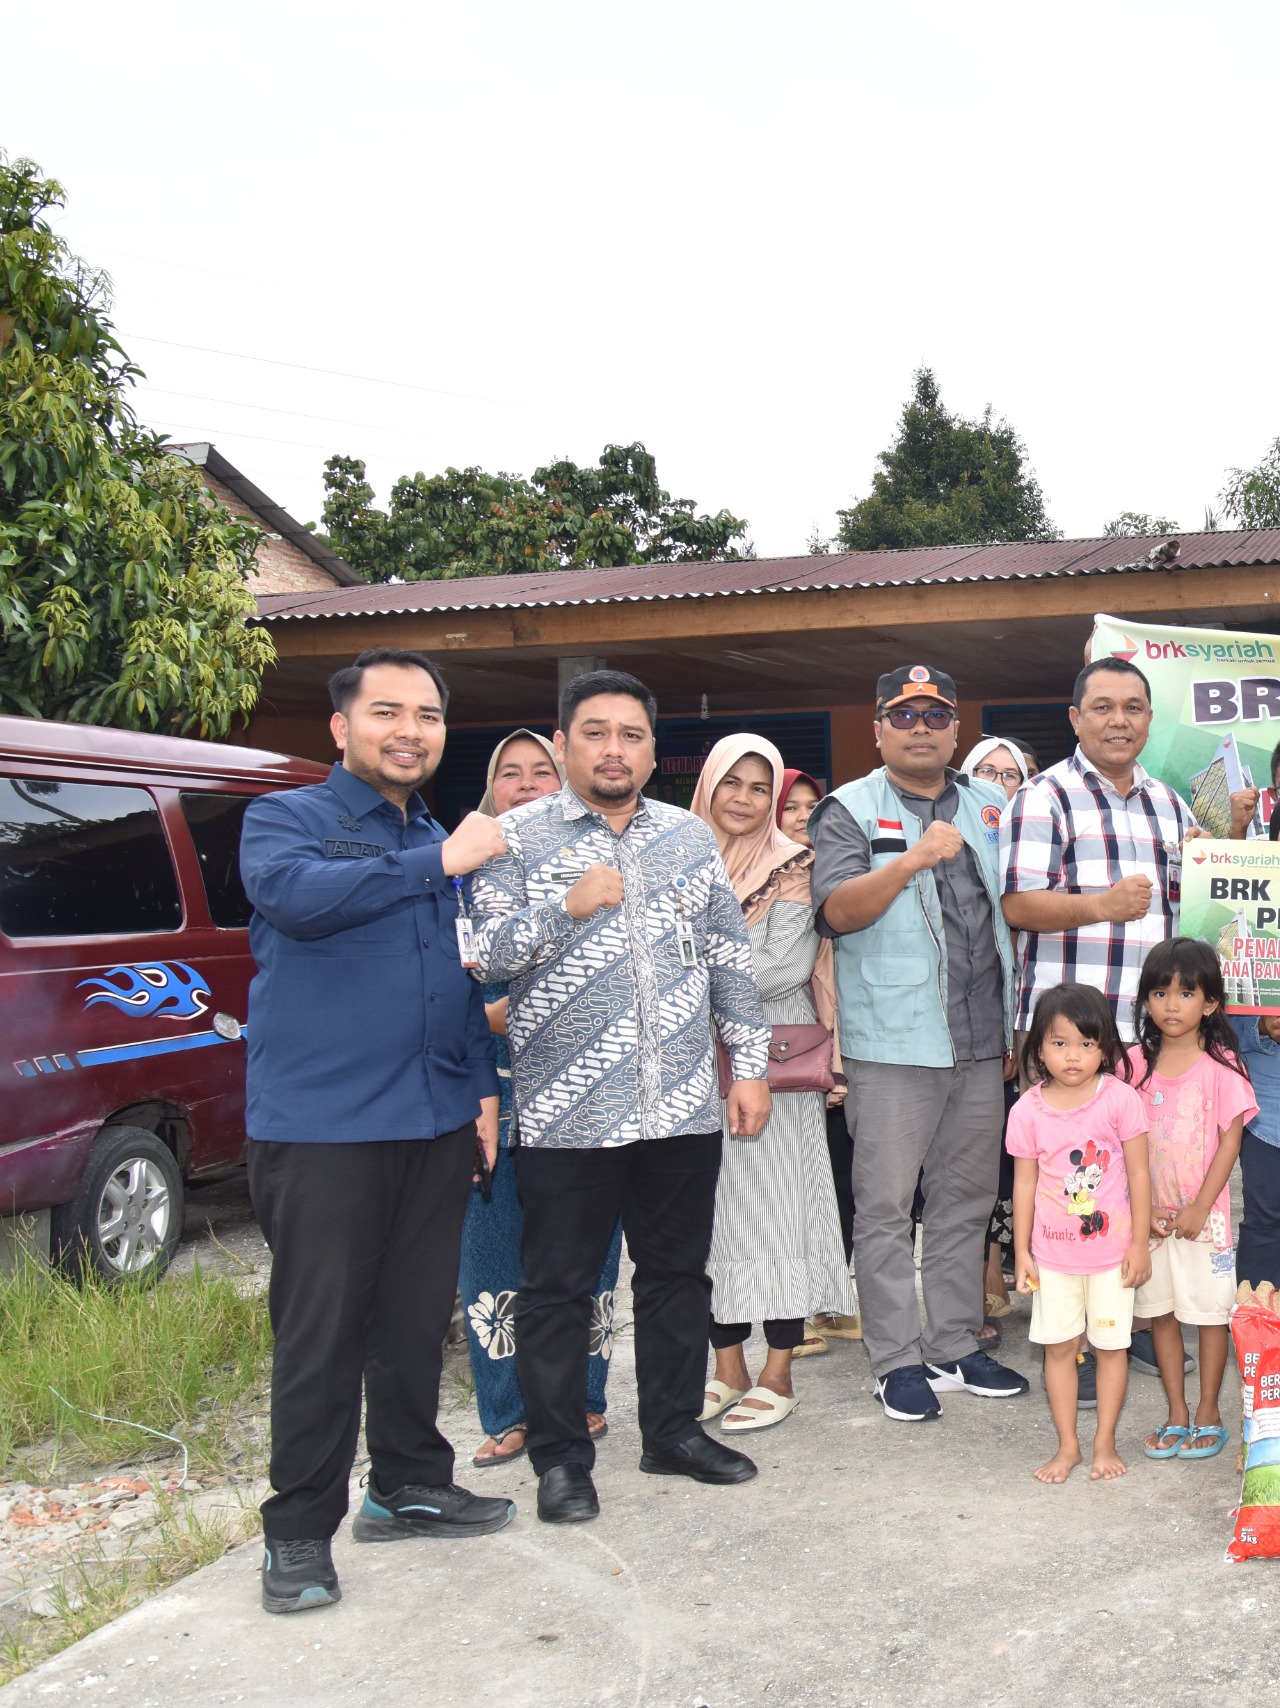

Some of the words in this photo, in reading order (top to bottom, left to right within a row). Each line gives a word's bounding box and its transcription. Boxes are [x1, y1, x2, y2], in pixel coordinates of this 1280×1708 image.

[1146, 640, 1274, 661] brksyariah
[662, 757, 693, 774] KETUA
[1210, 852, 1280, 867] brksyariah
[1209, 877, 1271, 902] BRK
